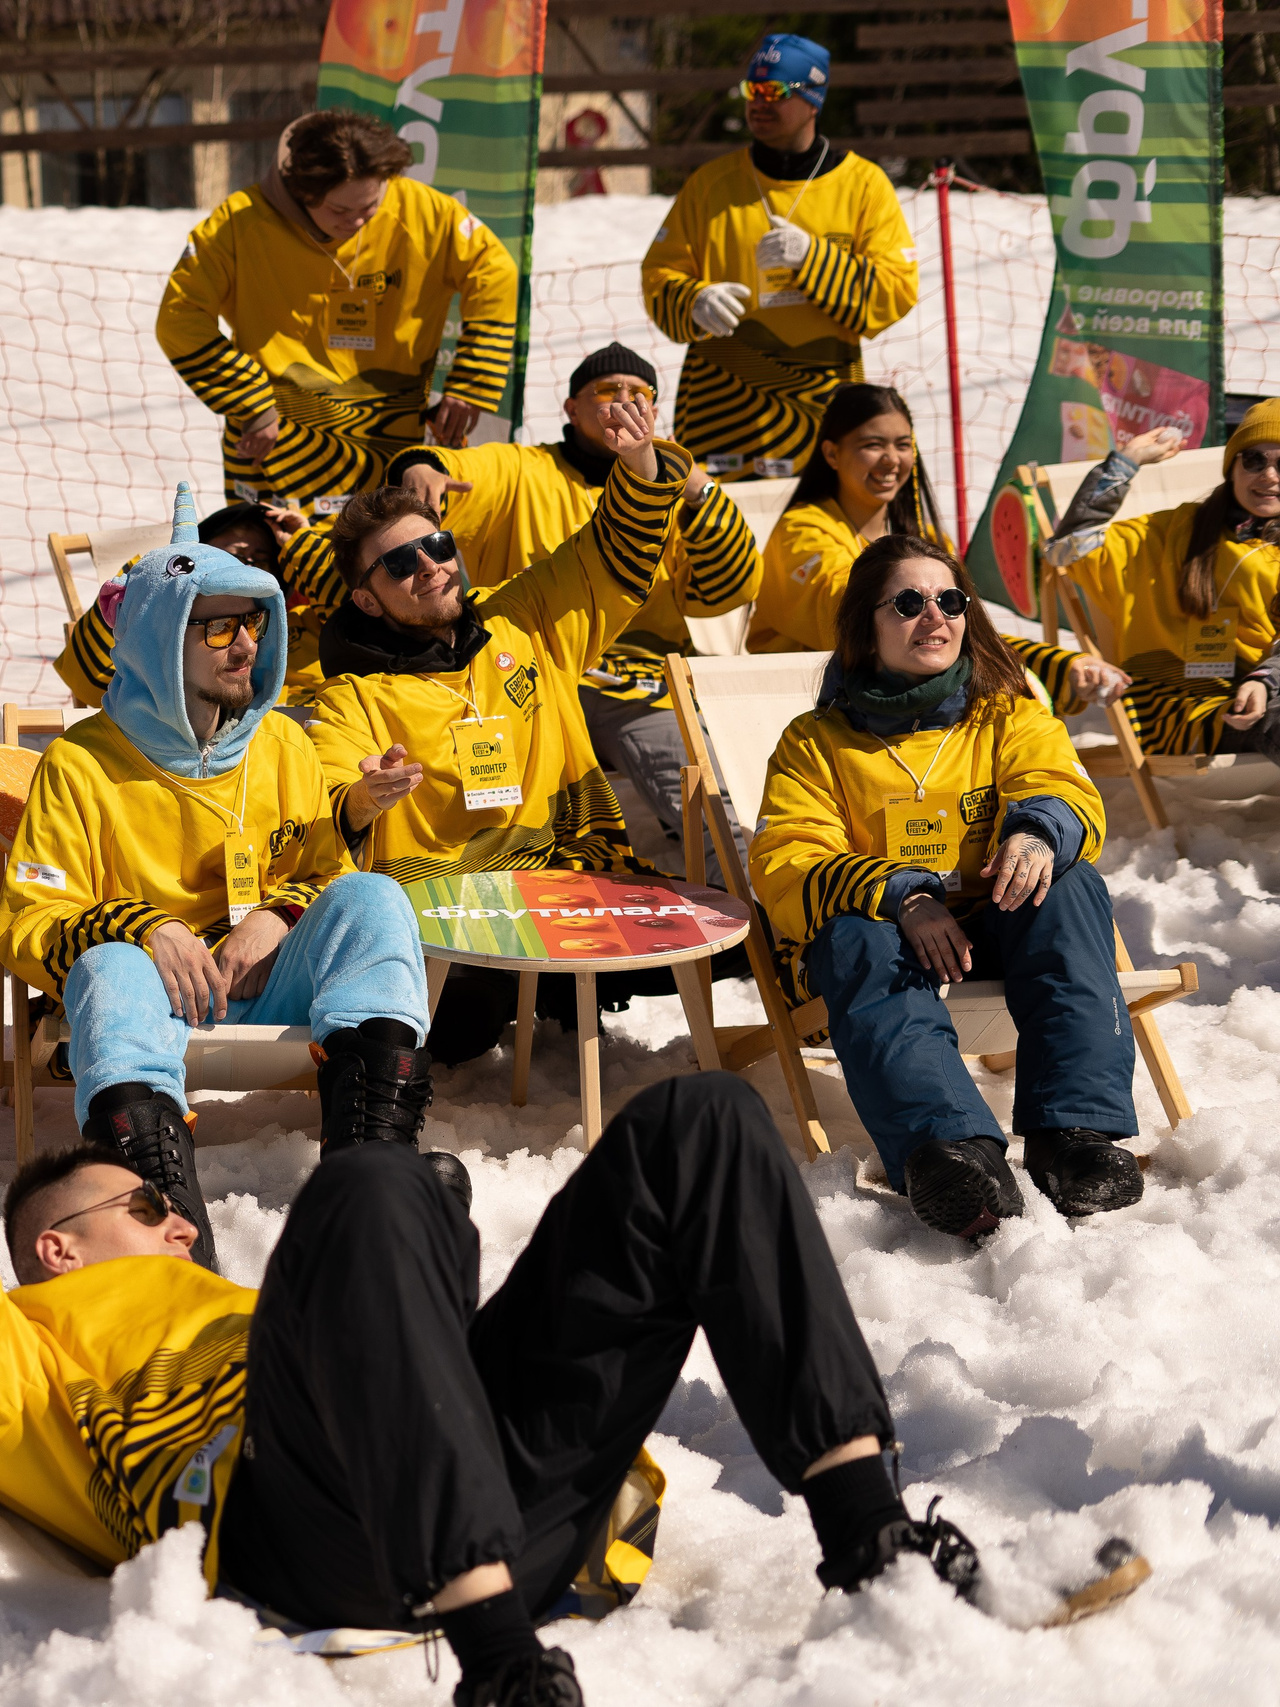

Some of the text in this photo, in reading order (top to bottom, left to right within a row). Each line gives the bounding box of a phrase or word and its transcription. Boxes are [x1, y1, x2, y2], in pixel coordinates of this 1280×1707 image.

[470, 762, 507, 776] ВОЛОНТЕР
[968, 804, 988, 821] FEST
[900, 843, 947, 857] ВОЛОНТЕР
[421, 905, 696, 920] фрутилад
